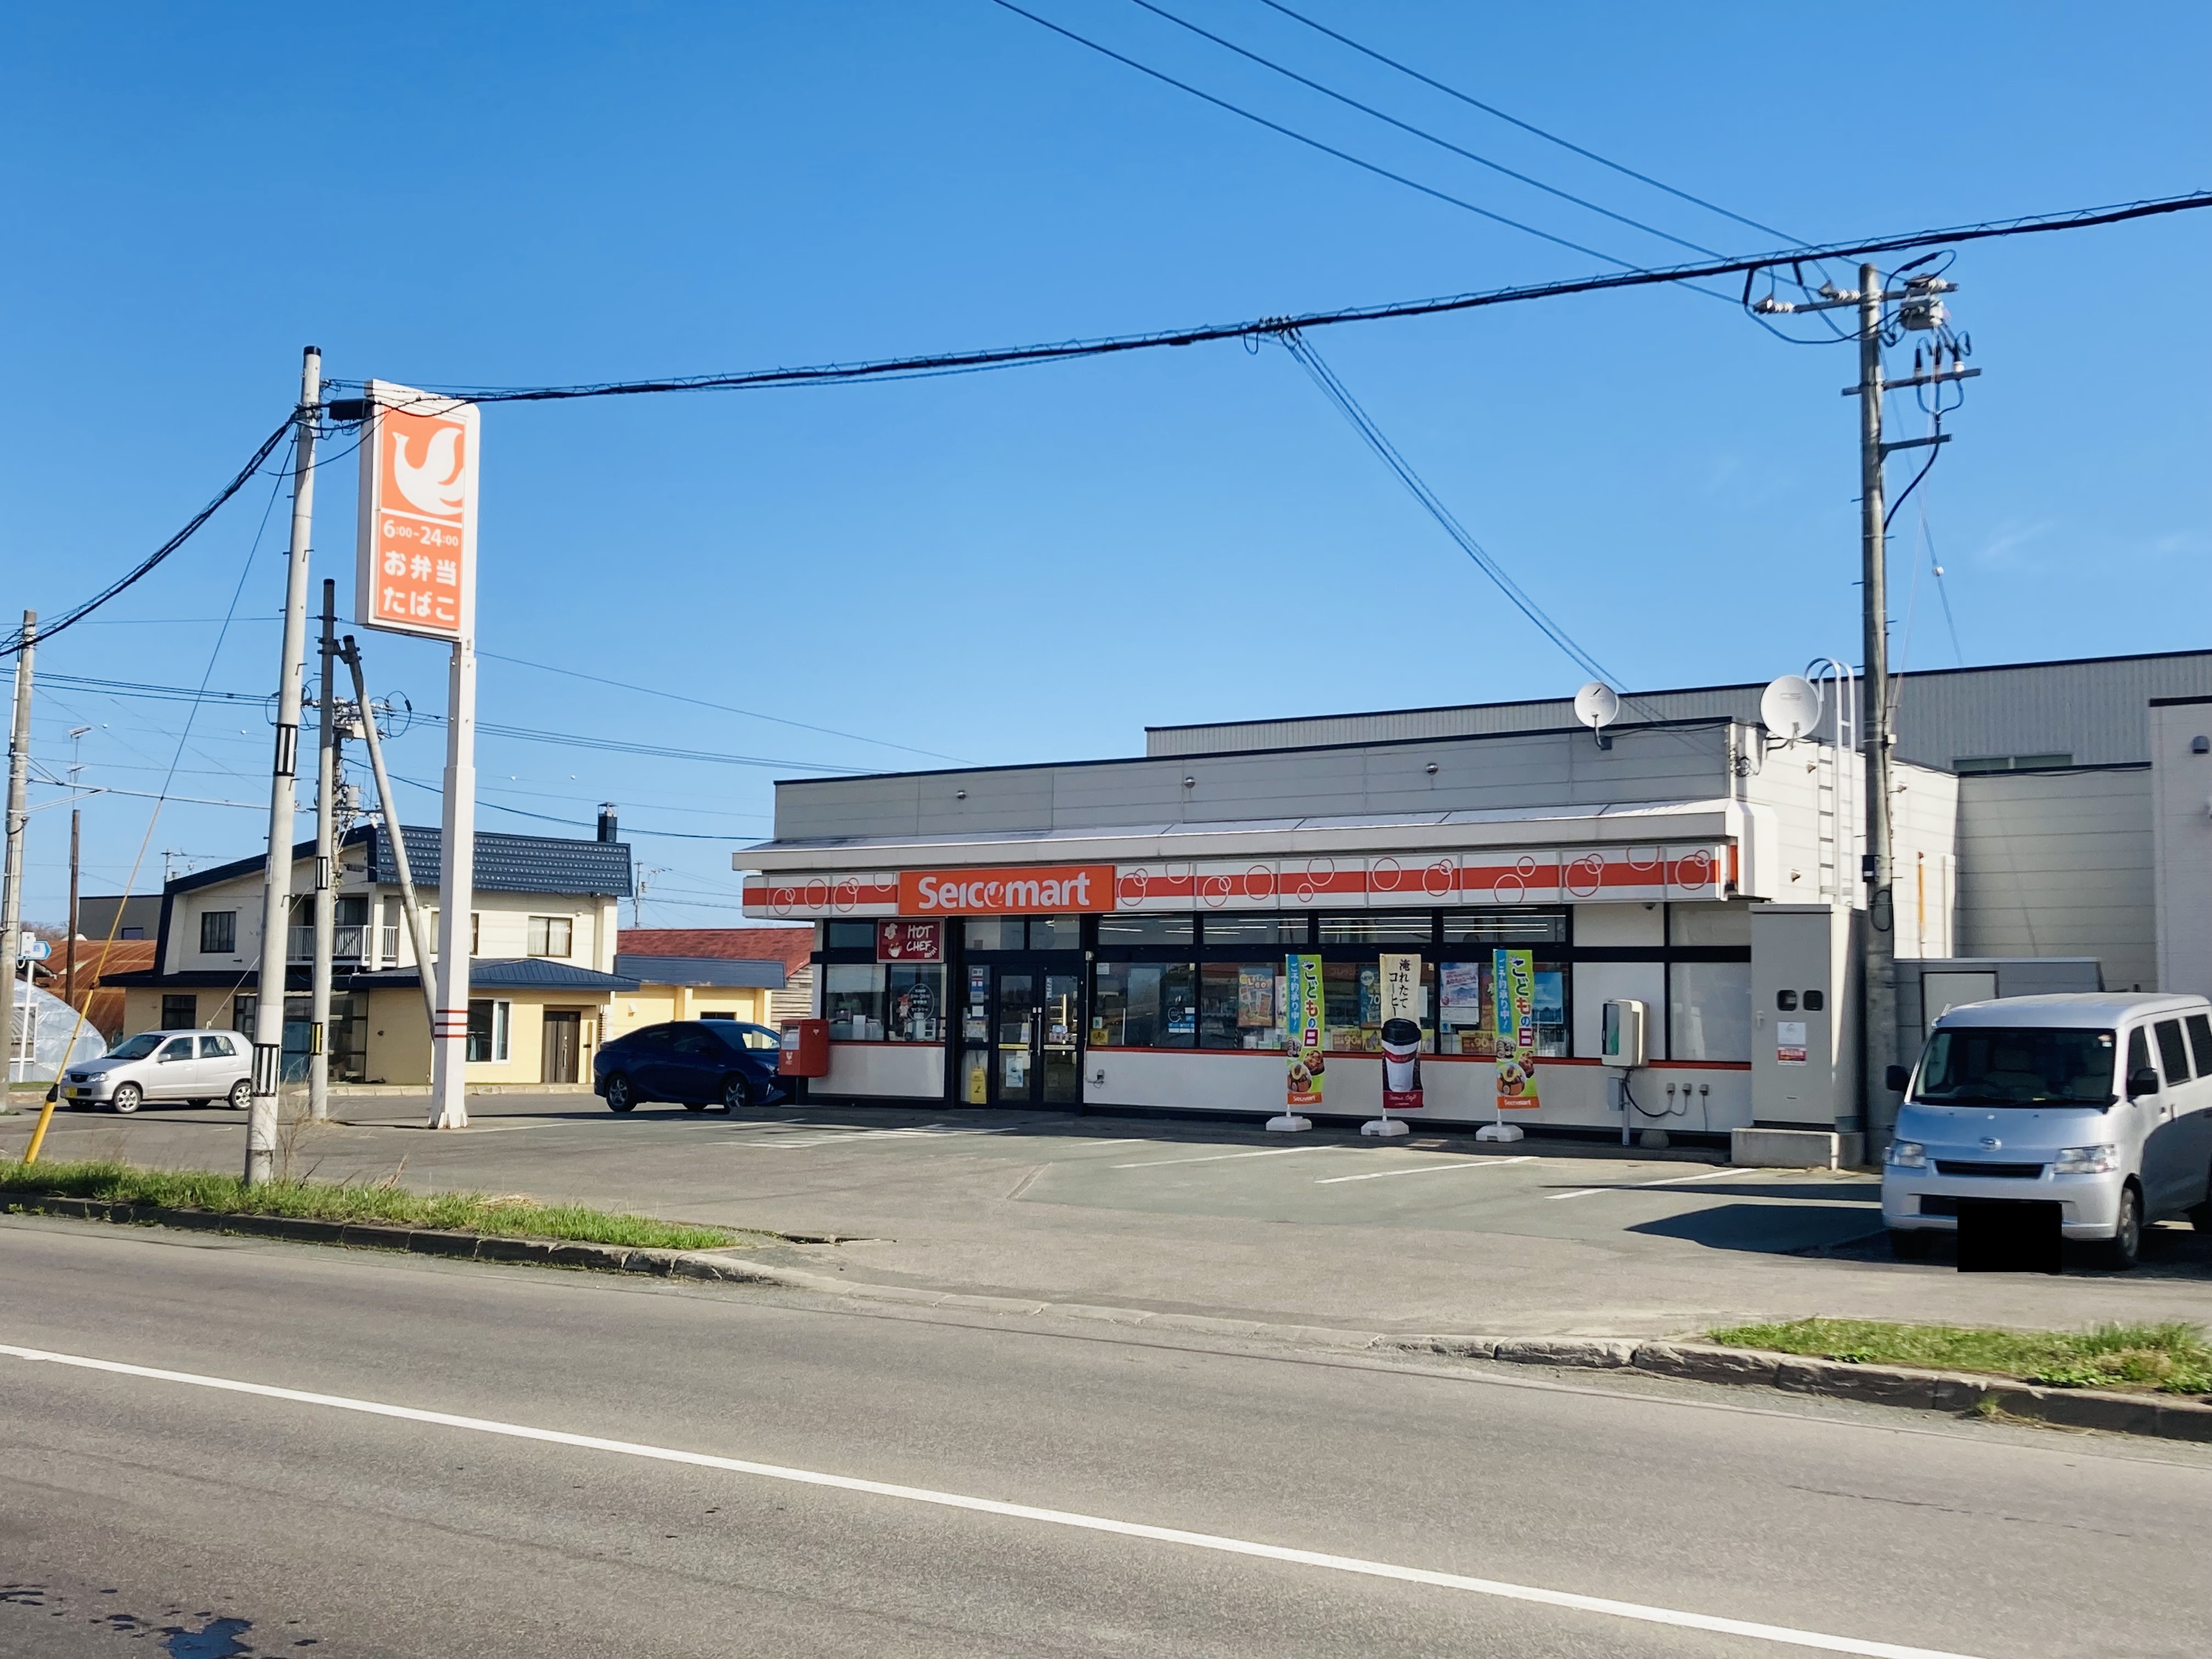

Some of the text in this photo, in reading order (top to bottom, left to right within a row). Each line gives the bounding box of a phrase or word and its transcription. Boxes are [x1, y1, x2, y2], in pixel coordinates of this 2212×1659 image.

[384, 550, 456, 586] お弁当
[383, 586, 455, 620] たばこ
[918, 872, 1091, 909] Seicomart
[906, 940, 933, 952] CHEF
[907, 924, 934, 939] HOT
[1389, 972, 1398, 1017] コーヒー
[1400, 959, 1410, 1008] 淹れたて
[1510, 957, 1532, 1047] こどもの日
[1302, 961, 1319, 1047] こどもの日
